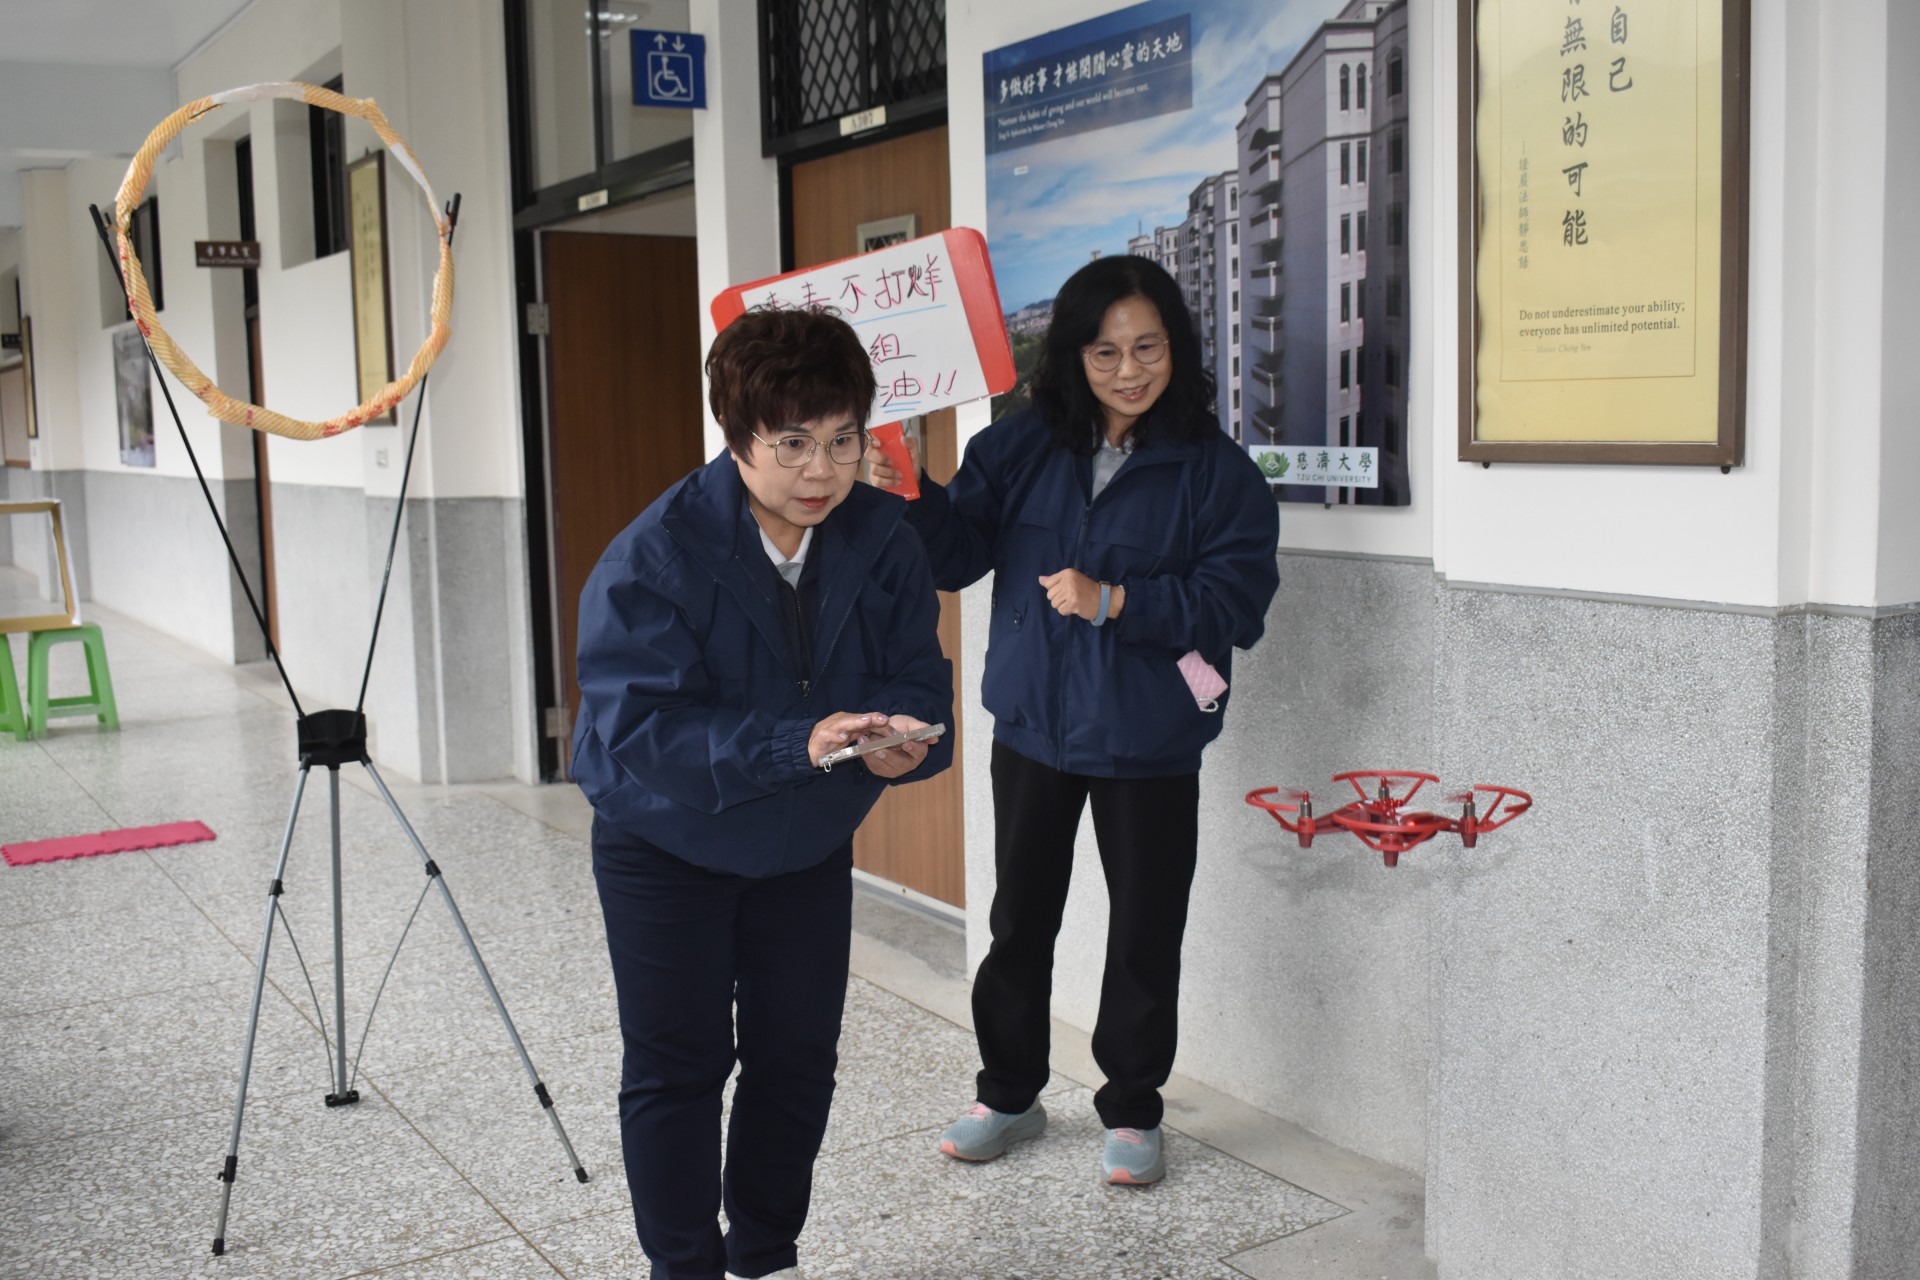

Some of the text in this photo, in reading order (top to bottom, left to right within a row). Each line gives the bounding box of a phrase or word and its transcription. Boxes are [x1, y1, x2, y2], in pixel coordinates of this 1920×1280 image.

[1609, 5, 1633, 92] 自己
[1000, 65, 1047, 104] 多做好事
[1018, 112, 1027, 122] the
[1065, 99, 1075, 111] and
[1086, 92, 1101, 105] world
[1102, 88, 1113, 100] will
[1559, 0, 1590, 247] 無限的可能
[1519, 299, 1685, 320] Do not underestimate your ability;
[1519, 317, 1680, 339] everyone has unlimited potential.
[1296, 450, 1373, 472] 慈濟大學
[1296, 473, 1372, 483] TZU CHI UNIVERSITY
